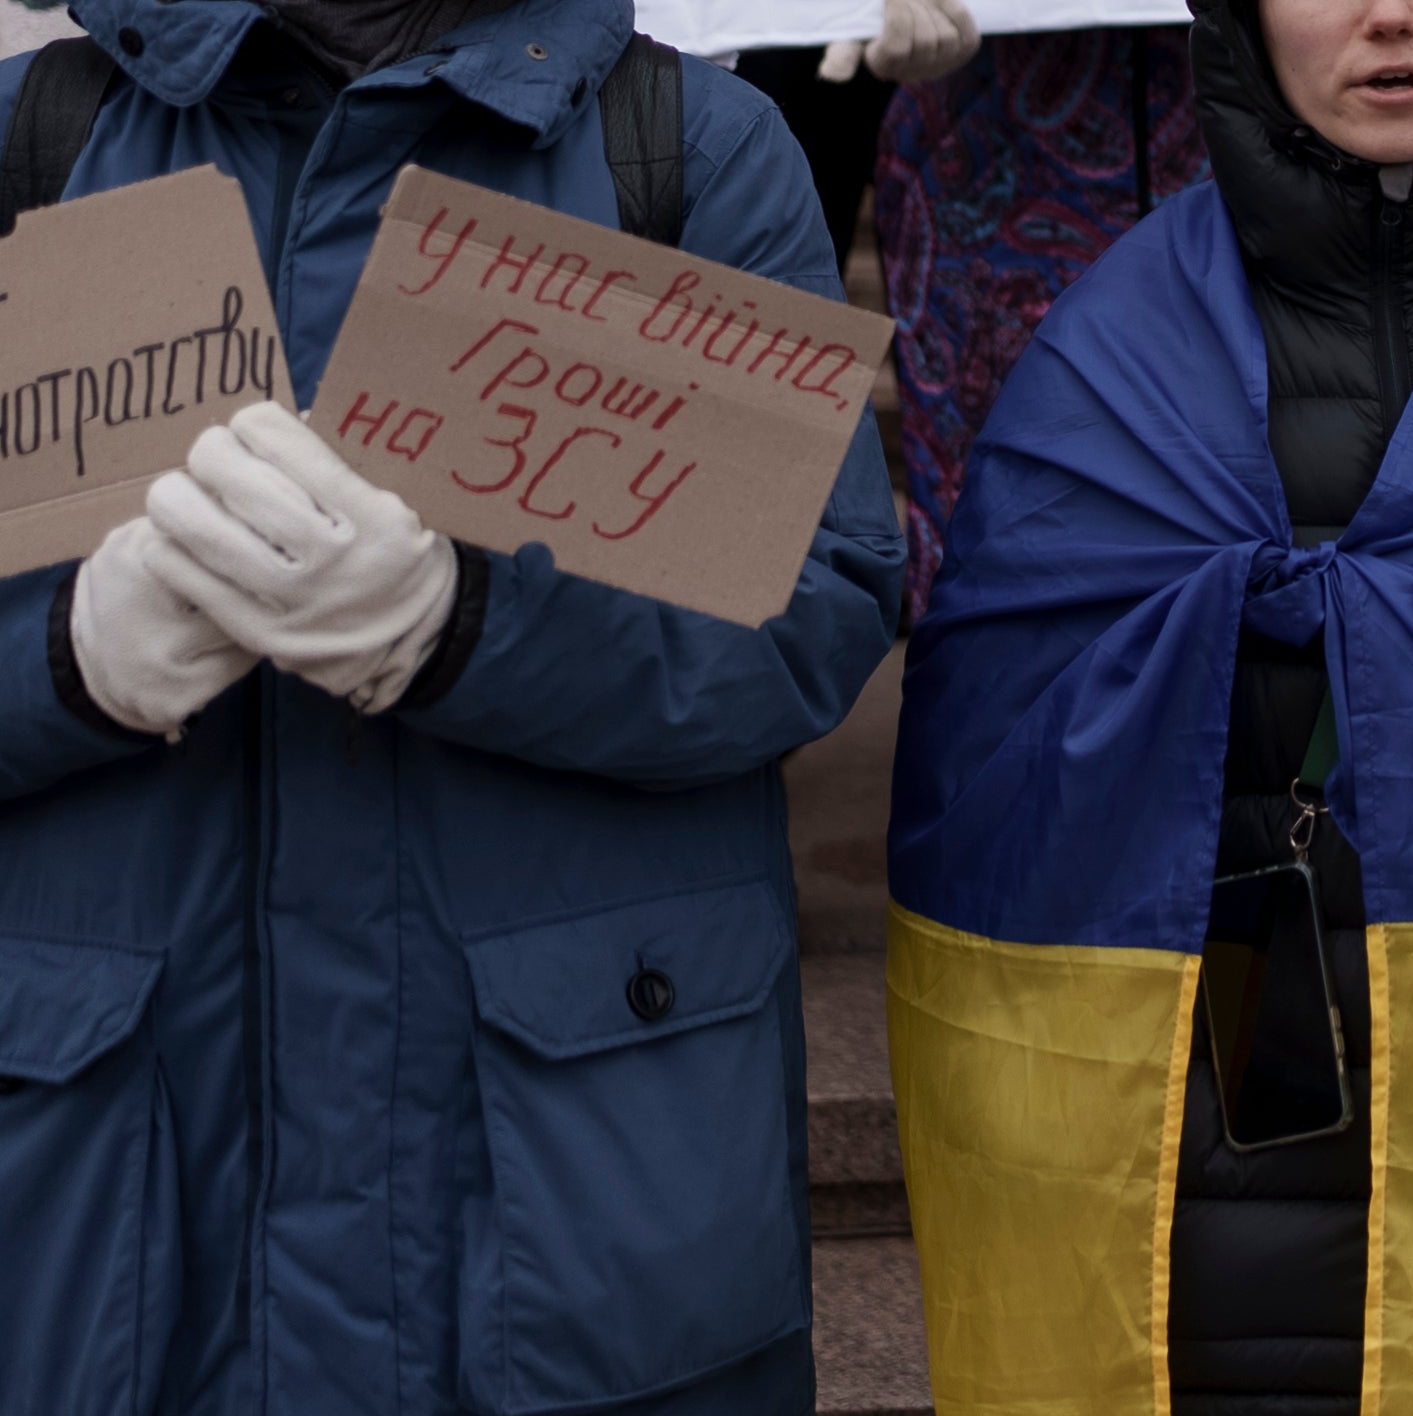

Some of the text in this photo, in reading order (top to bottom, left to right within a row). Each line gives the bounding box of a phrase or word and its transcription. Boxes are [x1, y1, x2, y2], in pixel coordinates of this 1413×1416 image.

[480, 240, 639, 324] нас
[450, 318, 698, 432] Гроші
[337, 389, 698, 542] на ЗСУ
